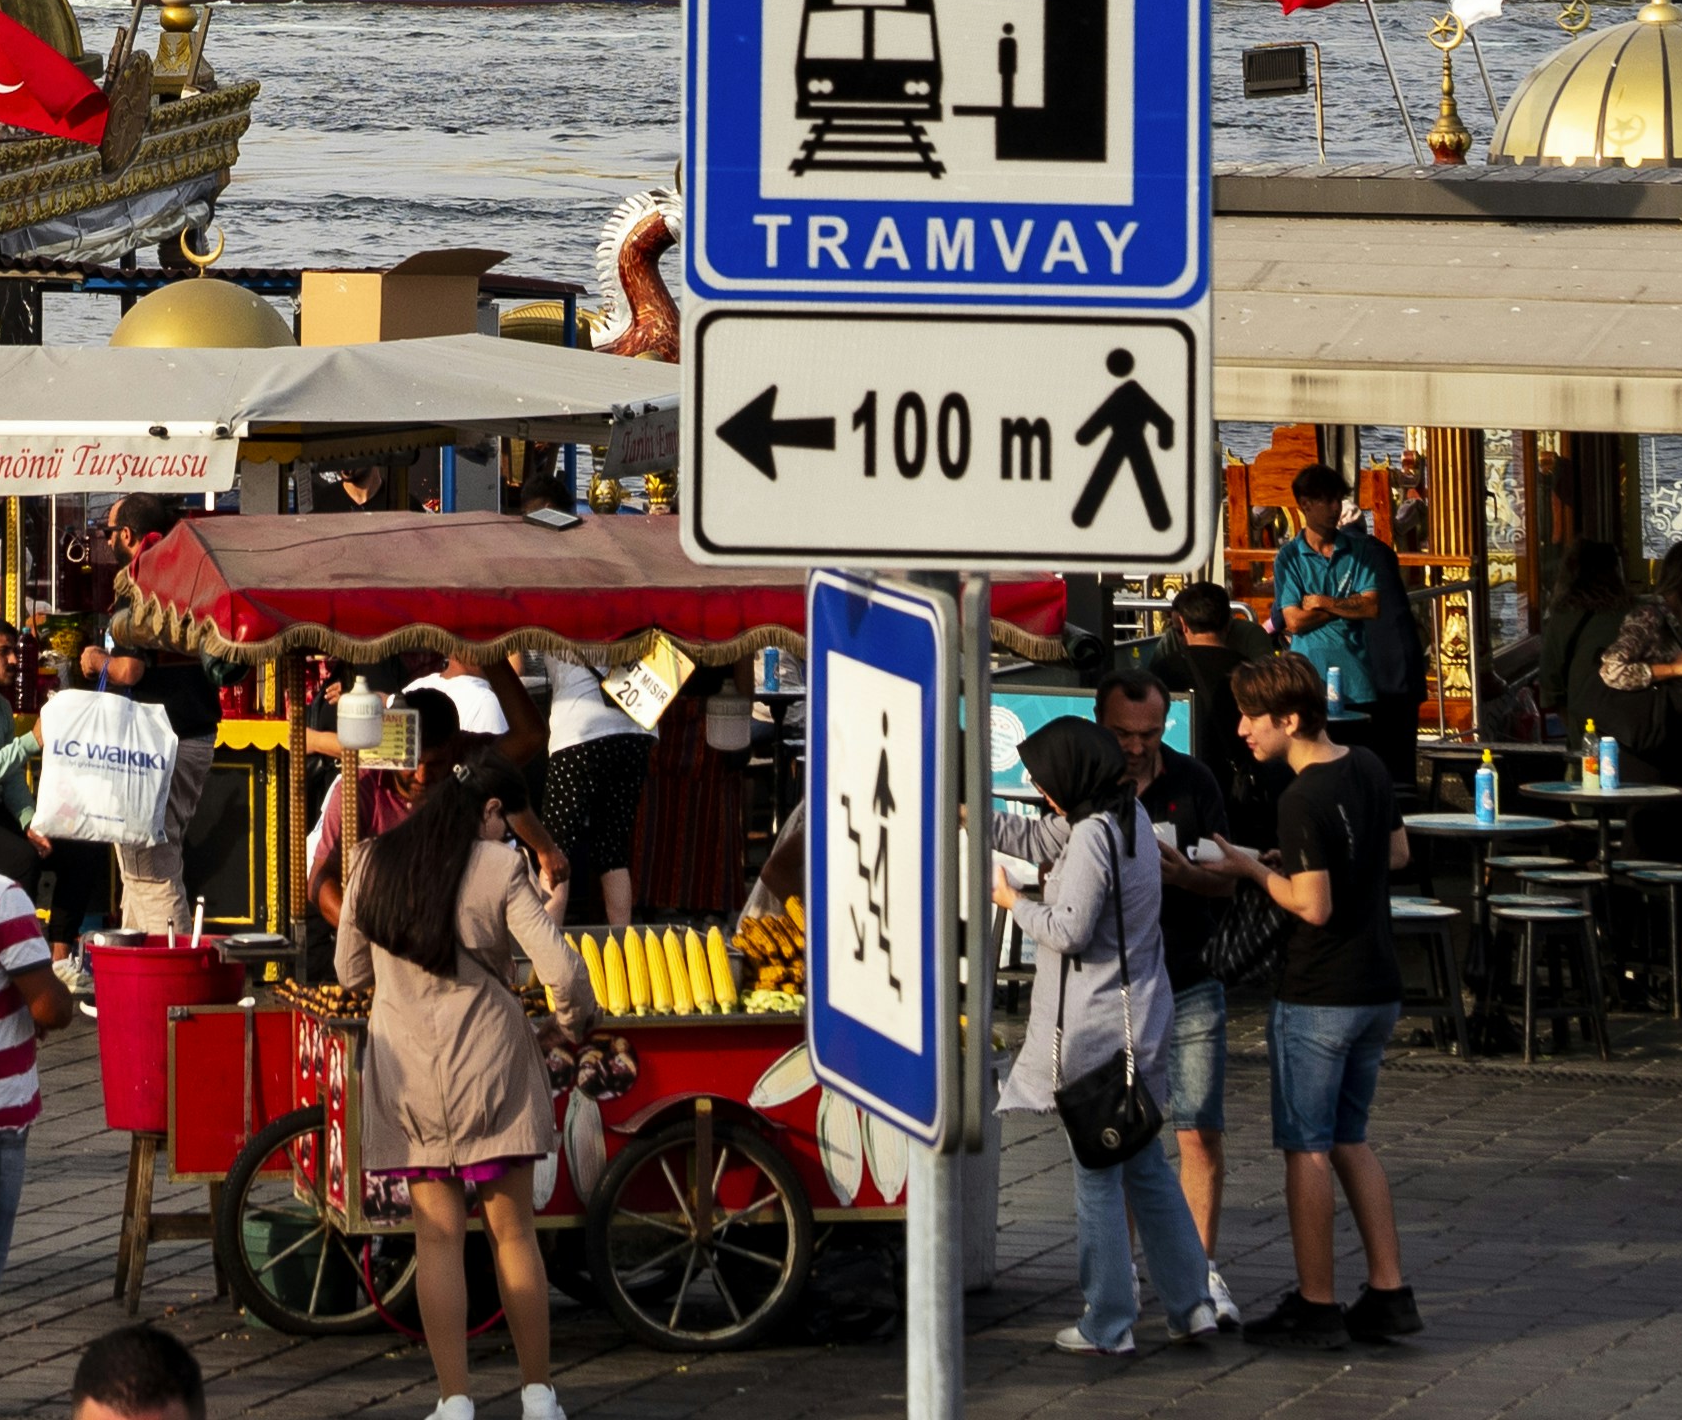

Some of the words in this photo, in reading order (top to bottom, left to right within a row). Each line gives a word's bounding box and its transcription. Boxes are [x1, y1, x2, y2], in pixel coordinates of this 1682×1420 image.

[753, 214, 1139, 274] TRAMVAY
[852, 390, 971, 480] 100
[1000, 416, 1052, 481] m
[72, 442, 208, 486] Turşucusu
[53, 739, 81, 758] LC
